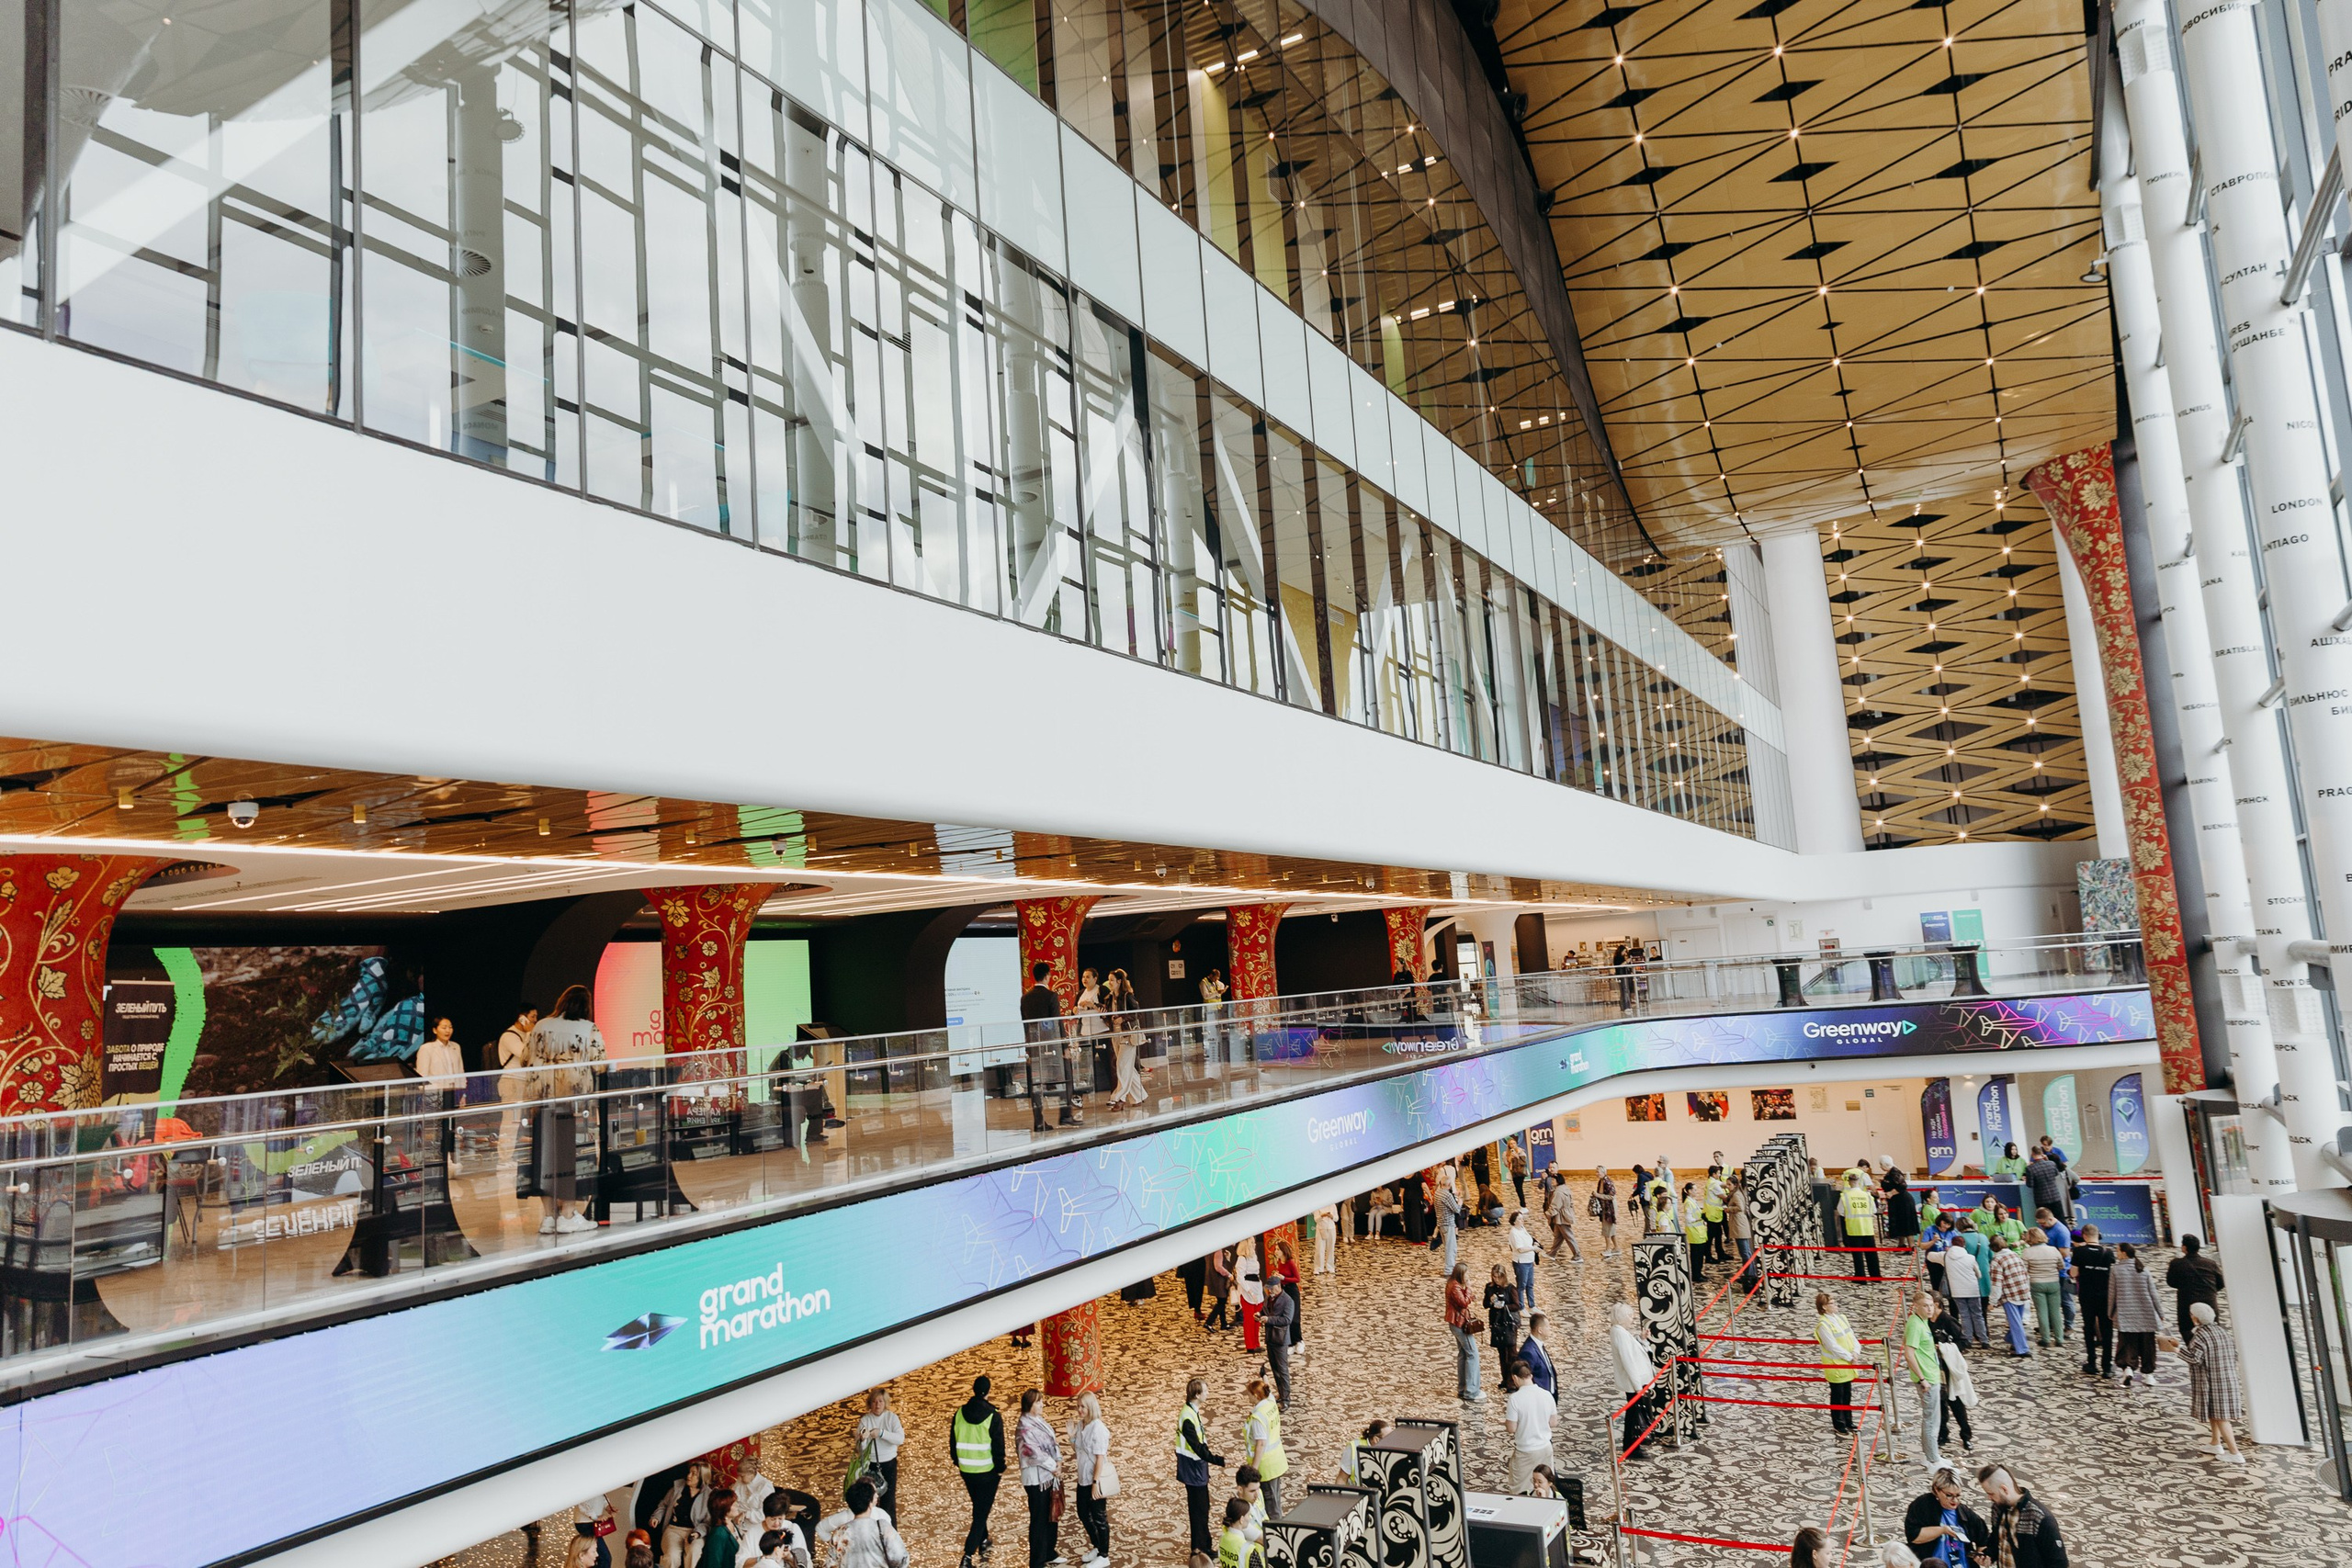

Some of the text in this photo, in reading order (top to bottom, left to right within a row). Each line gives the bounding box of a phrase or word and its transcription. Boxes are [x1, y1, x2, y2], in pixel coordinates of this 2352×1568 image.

[2271, 498, 2323, 513] LONDON
[1803, 1021, 1902, 1038] Greenway
[1837, 1036, 1883, 1044] GLOBAL
[1983, 1102, 1995, 1131] grand
[1990, 1085, 2003, 1132] marathon
[2059, 1085, 2075, 1145] marathon
[1307, 1110, 1367, 1144] Greenway
[1531, 1127, 1553, 1145] gm
[2048, 1107, 2064, 1145] grand
[2117, 1131, 2143, 1143] gm
[1929, 1146, 1953, 1158] gm
[288, 1156, 350, 1178] ЗЕЛЕНЫЙ
[2088, 1205, 2120, 1213] grand
[2088, 1212, 2139, 1220] marathon
[699, 1262, 784, 1324] grand
[700, 1289, 831, 1350] marathon
